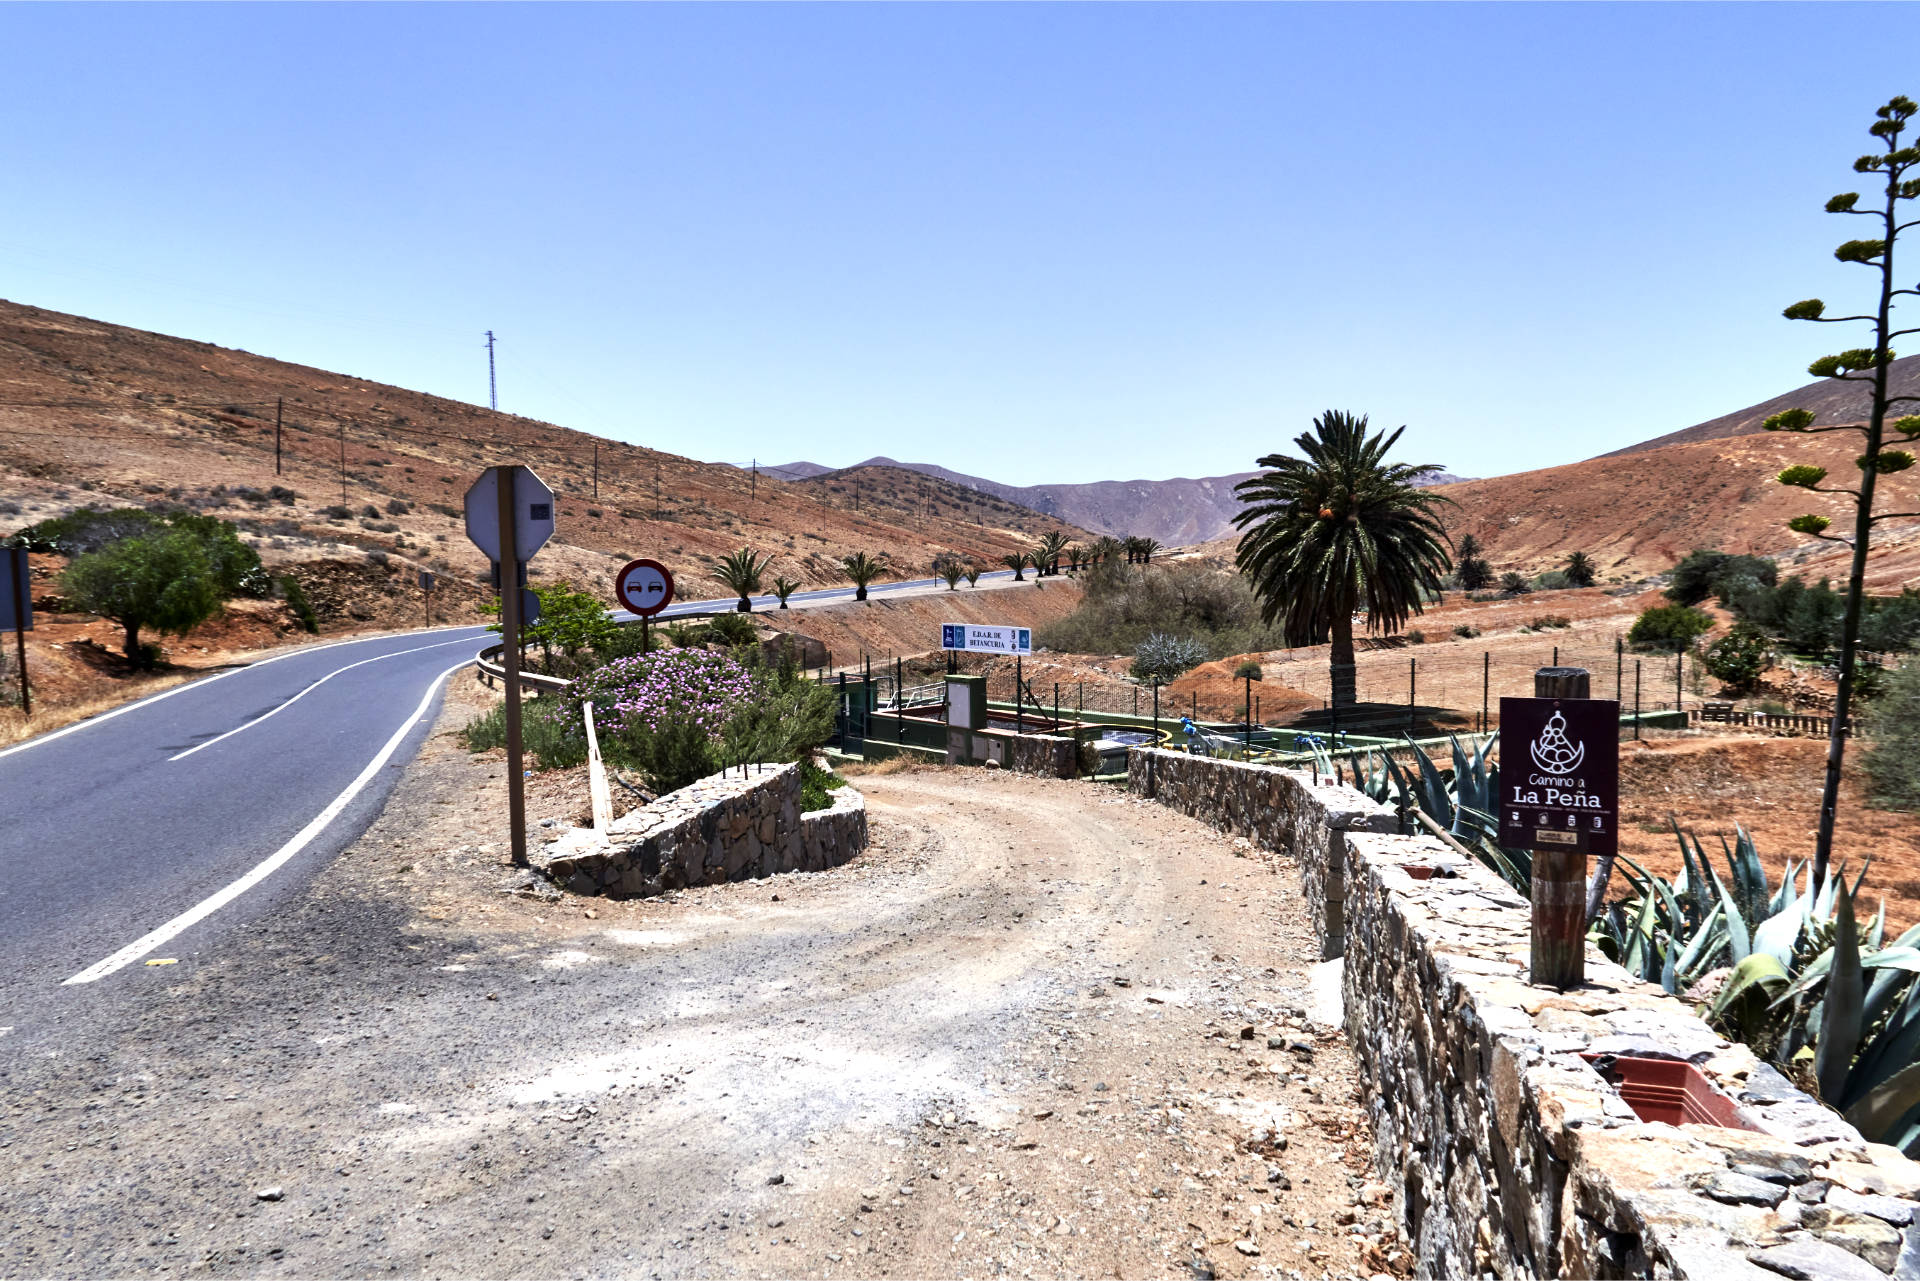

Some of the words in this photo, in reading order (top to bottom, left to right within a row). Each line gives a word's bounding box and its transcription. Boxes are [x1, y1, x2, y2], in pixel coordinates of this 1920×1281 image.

[970, 640, 1005, 648] BETANCURIA
[1529, 773, 1574, 787] Camino
[1578, 779, 1585, 788] a
[1513, 786, 1539, 804] La
[1545, 788, 1602, 808] Peña
